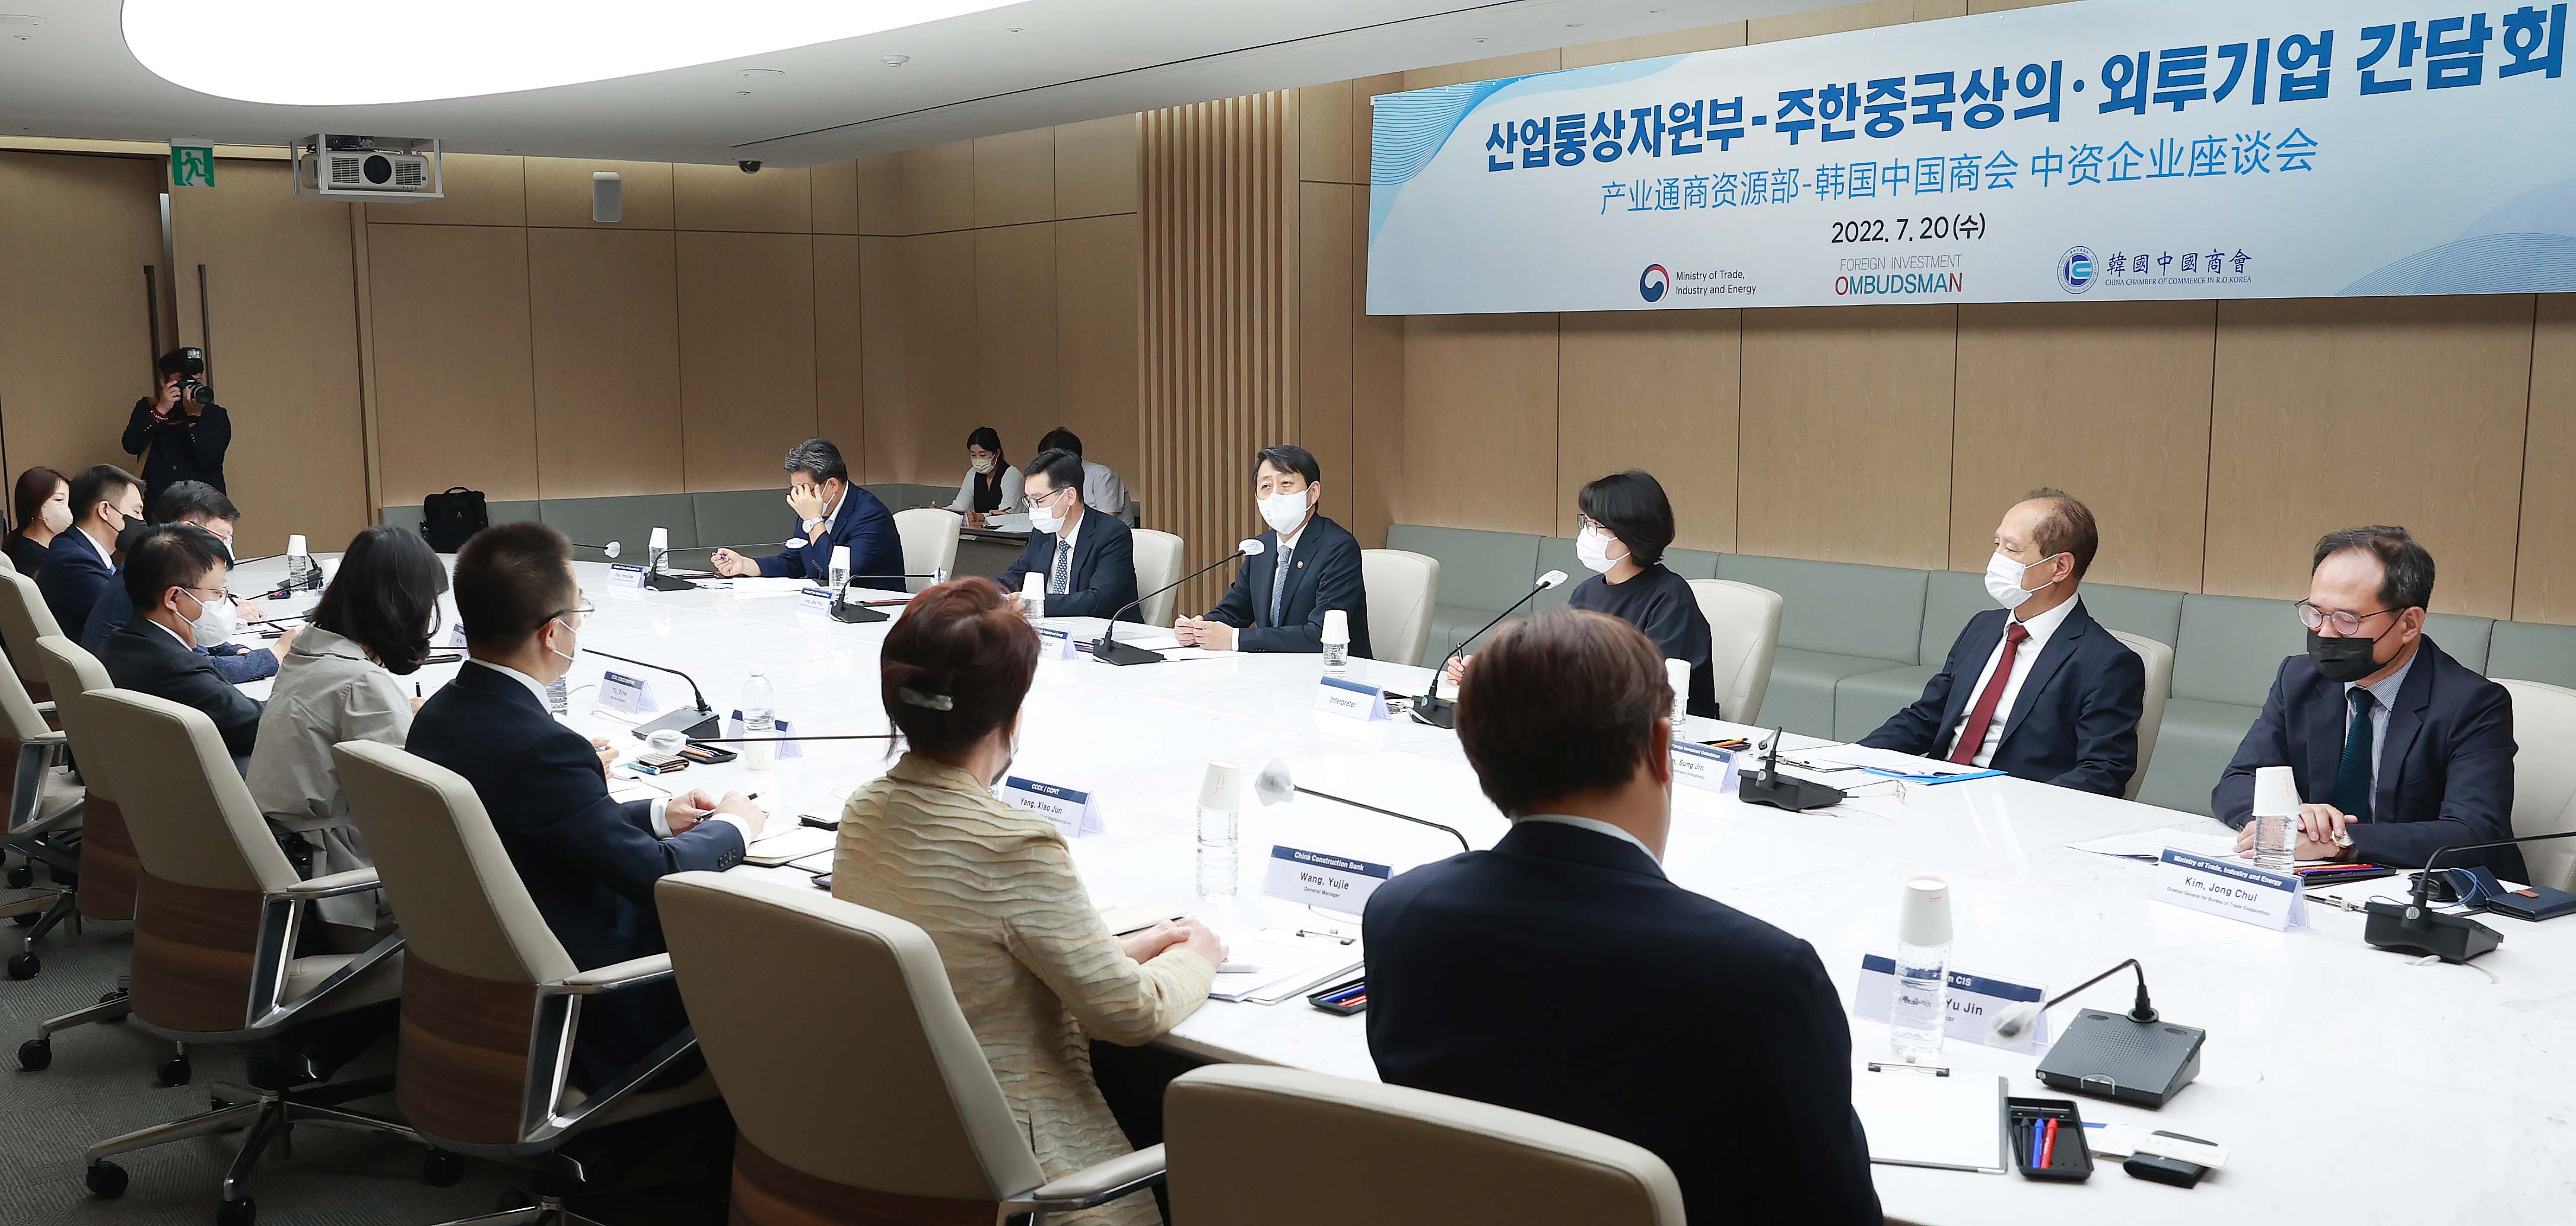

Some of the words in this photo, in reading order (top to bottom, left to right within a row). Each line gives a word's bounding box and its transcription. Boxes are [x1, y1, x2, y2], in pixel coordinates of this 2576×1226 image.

[2356, 3, 2568, 96] 간담회
[2031, 127, 2319, 188] 中资企业座谈会
[1840, 257, 1886, 271] FOREIGN
[1891, 254, 1963, 269] INVESTMENT
[2106, 248, 2253, 277] 韓國中國商會
[1676, 271, 1707, 282] Ministry
[1709, 270, 1718, 279] of
[1719, 269, 1745, 280] Trade,
[1835, 272, 1963, 296] OMBUDSMAN
[1675, 285, 1707, 297] Industry
[1709, 284, 1725, 294] and
[1728, 284, 1757, 296] Energy
[1330, 696, 1357, 709] Interpreter
[1679, 759, 1694, 770] Sung
[1694, 763, 1704, 771] Jin
[1037, 801, 1050, 812] Xiao
[1051, 805, 1063, 815] Jun
[1294, 851, 1311, 861] China
[1311, 855, 1349, 868] Construction
[1349, 860, 1365, 871] Bank
[2173, 855, 2197, 867] Ministry
[2204, 862, 2223, 873] Trade,
[2223, 866, 2249, 879] Industry
[2248, 873, 2262, 881] and
[2261, 875, 2284, 887] Energy
[1300, 872, 1325, 886] Wang,
[1328, 877, 1350, 890] Yujie
[2184, 876, 2206, 891] Kim,
[2209, 882, 2232, 897] Jong
[2235, 889, 2258, 903] Chul
[1304, 886, 1321, 895] General
[1321, 890, 1341, 899] Manager
[2166, 886, 2184, 894] Director
[2184, 890, 2200, 899] General
[2208, 896, 2224, 905] Bureau
[2230, 901, 2243, 910] Trade
[2243, 905, 2271, 916] Cooperation
[1955, 976, 1971, 987] CIS
[1963, 1002, 1983, 1016] Jin
